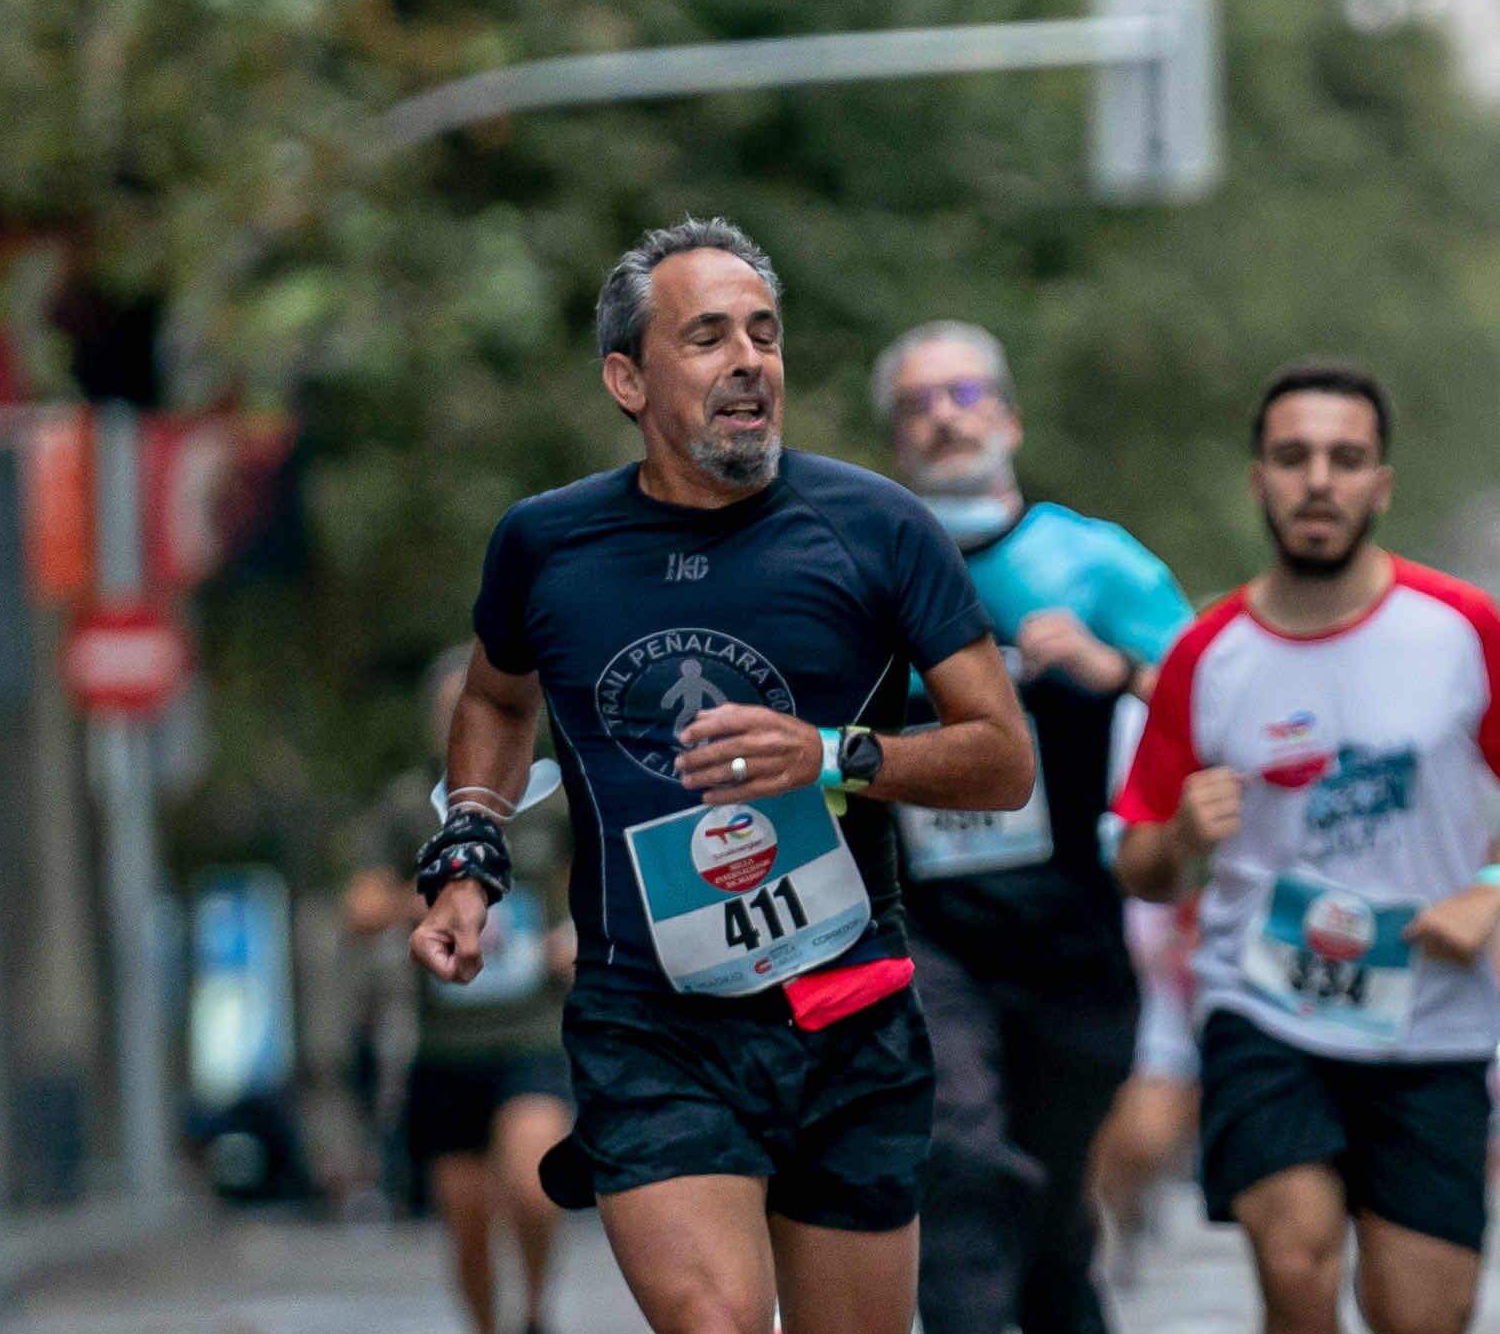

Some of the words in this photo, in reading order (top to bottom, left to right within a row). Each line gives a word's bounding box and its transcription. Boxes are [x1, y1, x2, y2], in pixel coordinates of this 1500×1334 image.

[601, 669, 632, 728] TRAIL
[630, 630, 769, 684] PEÑALARA
[724, 874, 809, 951] 411
